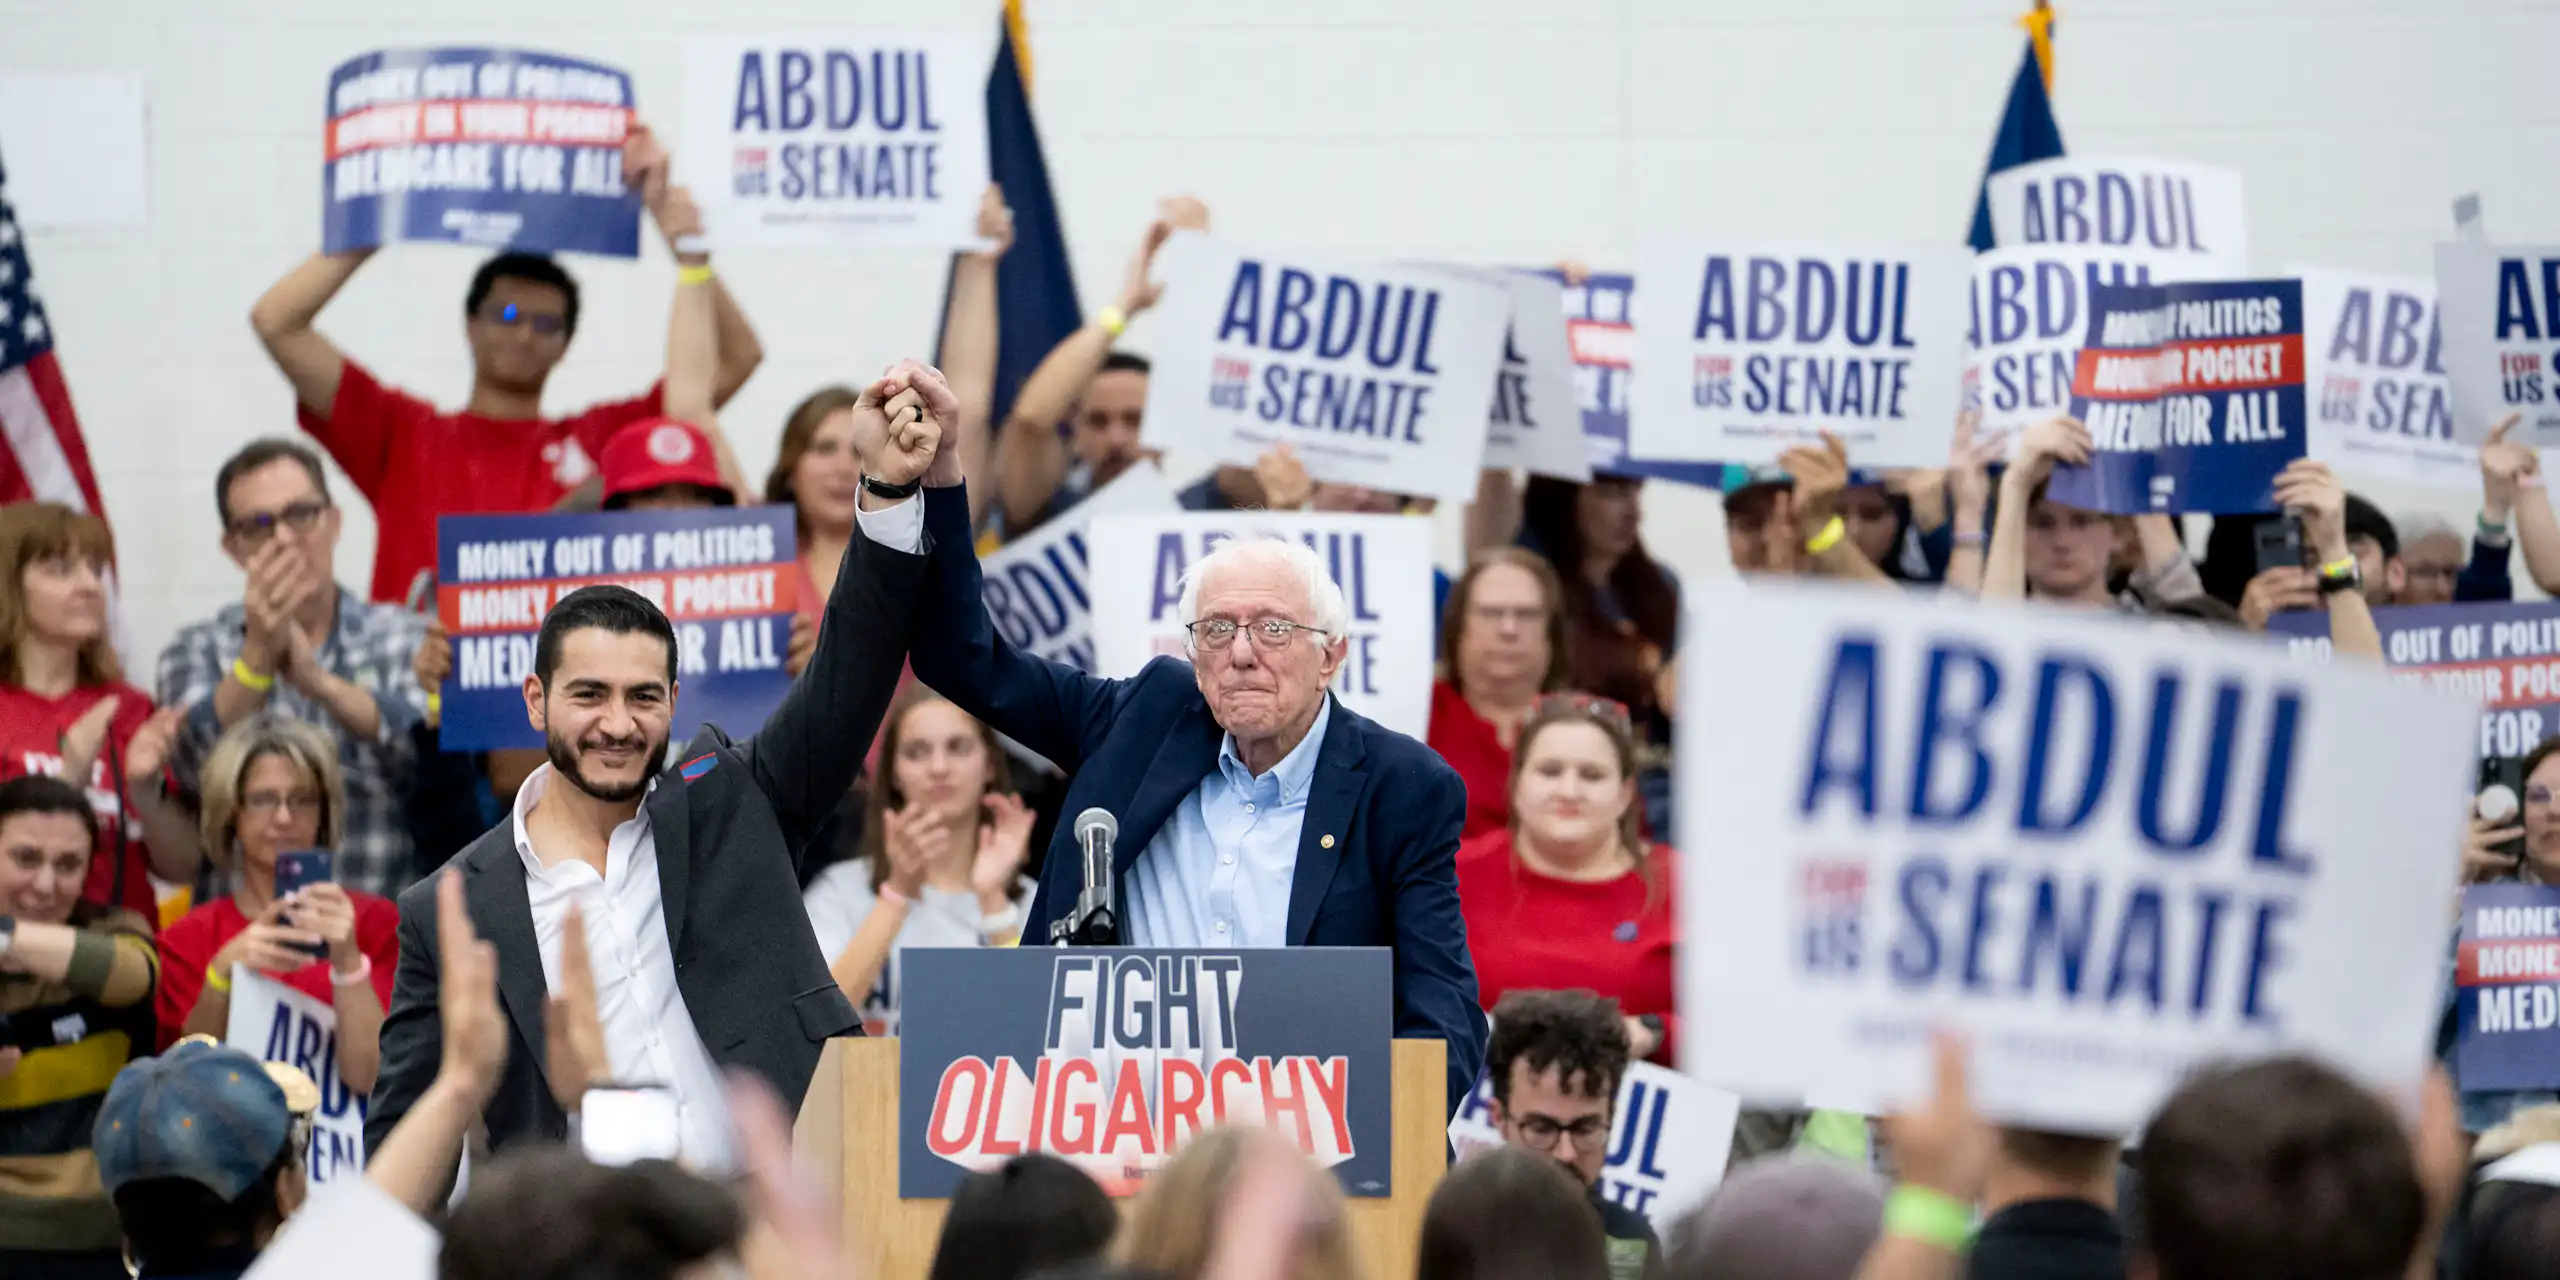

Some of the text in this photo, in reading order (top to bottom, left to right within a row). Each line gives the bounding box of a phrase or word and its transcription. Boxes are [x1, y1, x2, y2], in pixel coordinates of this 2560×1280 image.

[733, 50, 941, 132] ABDUL
[503, 144, 563, 195] FOR
[571, 146, 628, 197] ALL
[780, 143, 941, 201] SENATE
[2024, 172, 2210, 253] ABDUL
[1217, 259, 1441, 375] ABDUL
[1694, 255, 1916, 348] ABDUL
[1744, 354, 1912, 419] SENATE
[2188, 342, 2284, 386] POCKET
[2501, 351, 2541, 377] FOR
[2503, 375, 2544, 405] US
[1257, 362, 1433, 443] SENATE
[2165, 395, 2213, 446] FOR
[2225, 390, 2287, 443] ALL
[457, 523, 775, 582] MONEY OUT OF POLITICS
[459, 582, 549, 628] MONEY
[673, 571, 777, 616] POCKET
[719, 616, 781, 672] ALL
[2390, 628, 2442, 663] OUT
[2451, 624, 2484, 661] OF
[1798, 630, 2316, 872] ABDUL
[2480, 709, 2543, 758] FOR
[1888, 857, 2296, 1022] SENATE
[2477, 905, 2560, 938] MONE
[2477, 943, 2560, 978] MONE
[1045, 954, 1243, 1053] FIGHT
[926, 1056, 1356, 1160] OLIGARCHY
